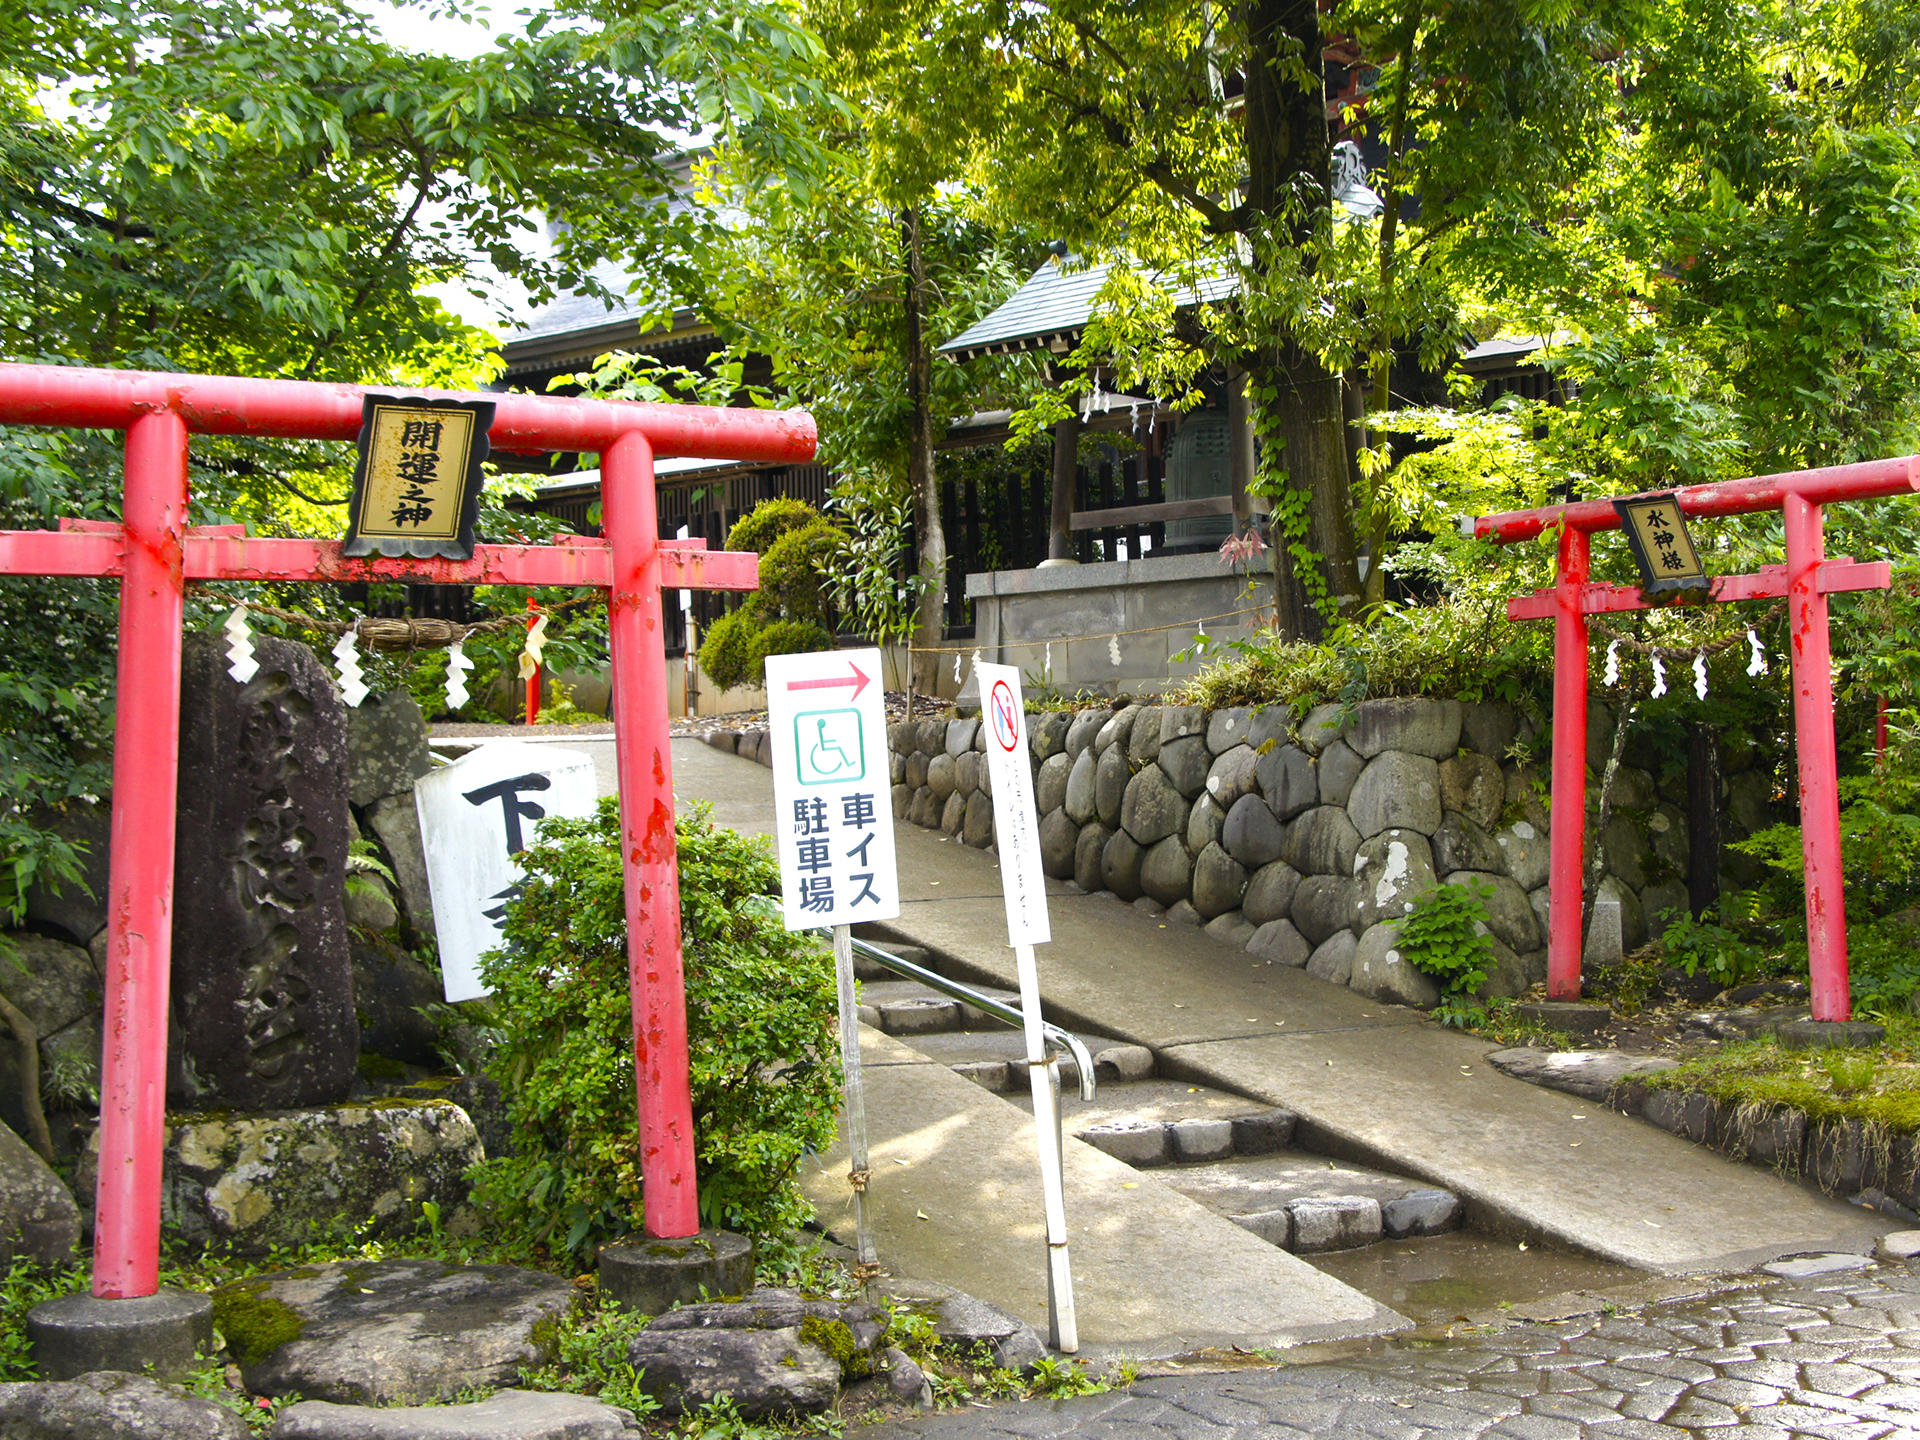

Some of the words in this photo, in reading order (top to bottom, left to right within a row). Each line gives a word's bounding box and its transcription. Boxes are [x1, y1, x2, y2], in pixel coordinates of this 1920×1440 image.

[387, 419, 444, 529] 開運之神
[1646, 508, 1686, 571] 水神様
[793, 796, 835, 914] 駐車場
[841, 792, 882, 908] 車イス
